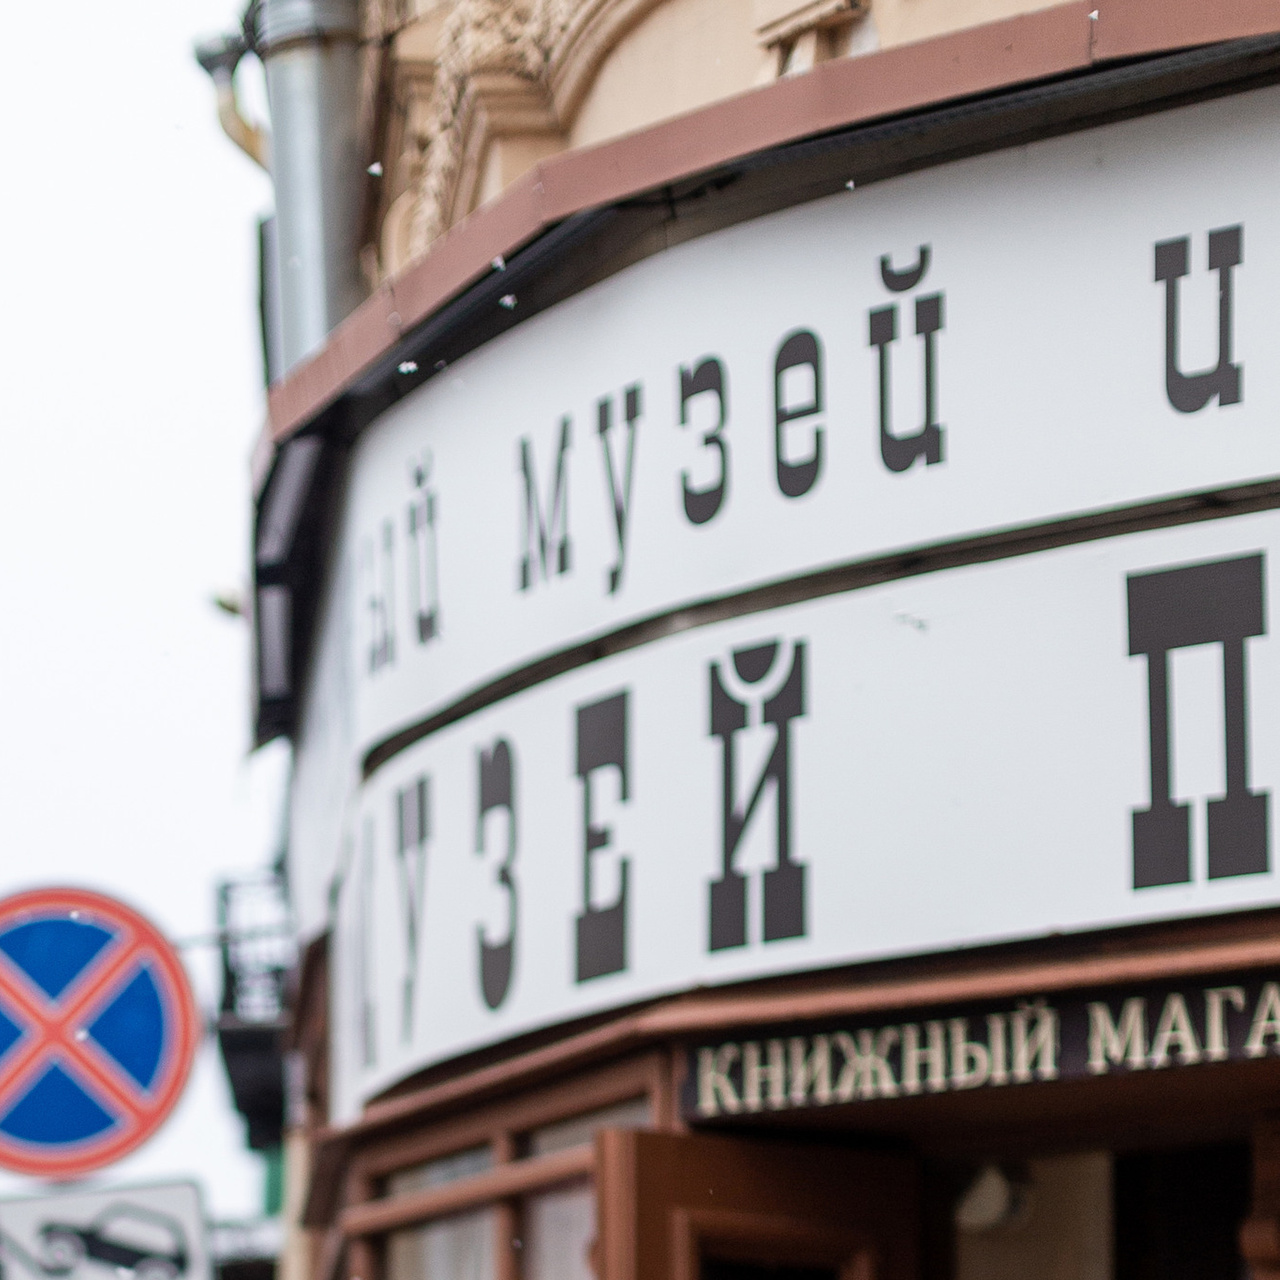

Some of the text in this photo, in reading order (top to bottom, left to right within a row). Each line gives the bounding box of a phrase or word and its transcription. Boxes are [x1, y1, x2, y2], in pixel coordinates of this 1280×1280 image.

[517, 246, 947, 594] музей
[1152, 223, 1245, 414] и
[1124, 549, 1274, 891] П
[696, 981, 1280, 1118] КНИЖНЫЙ МАГА
